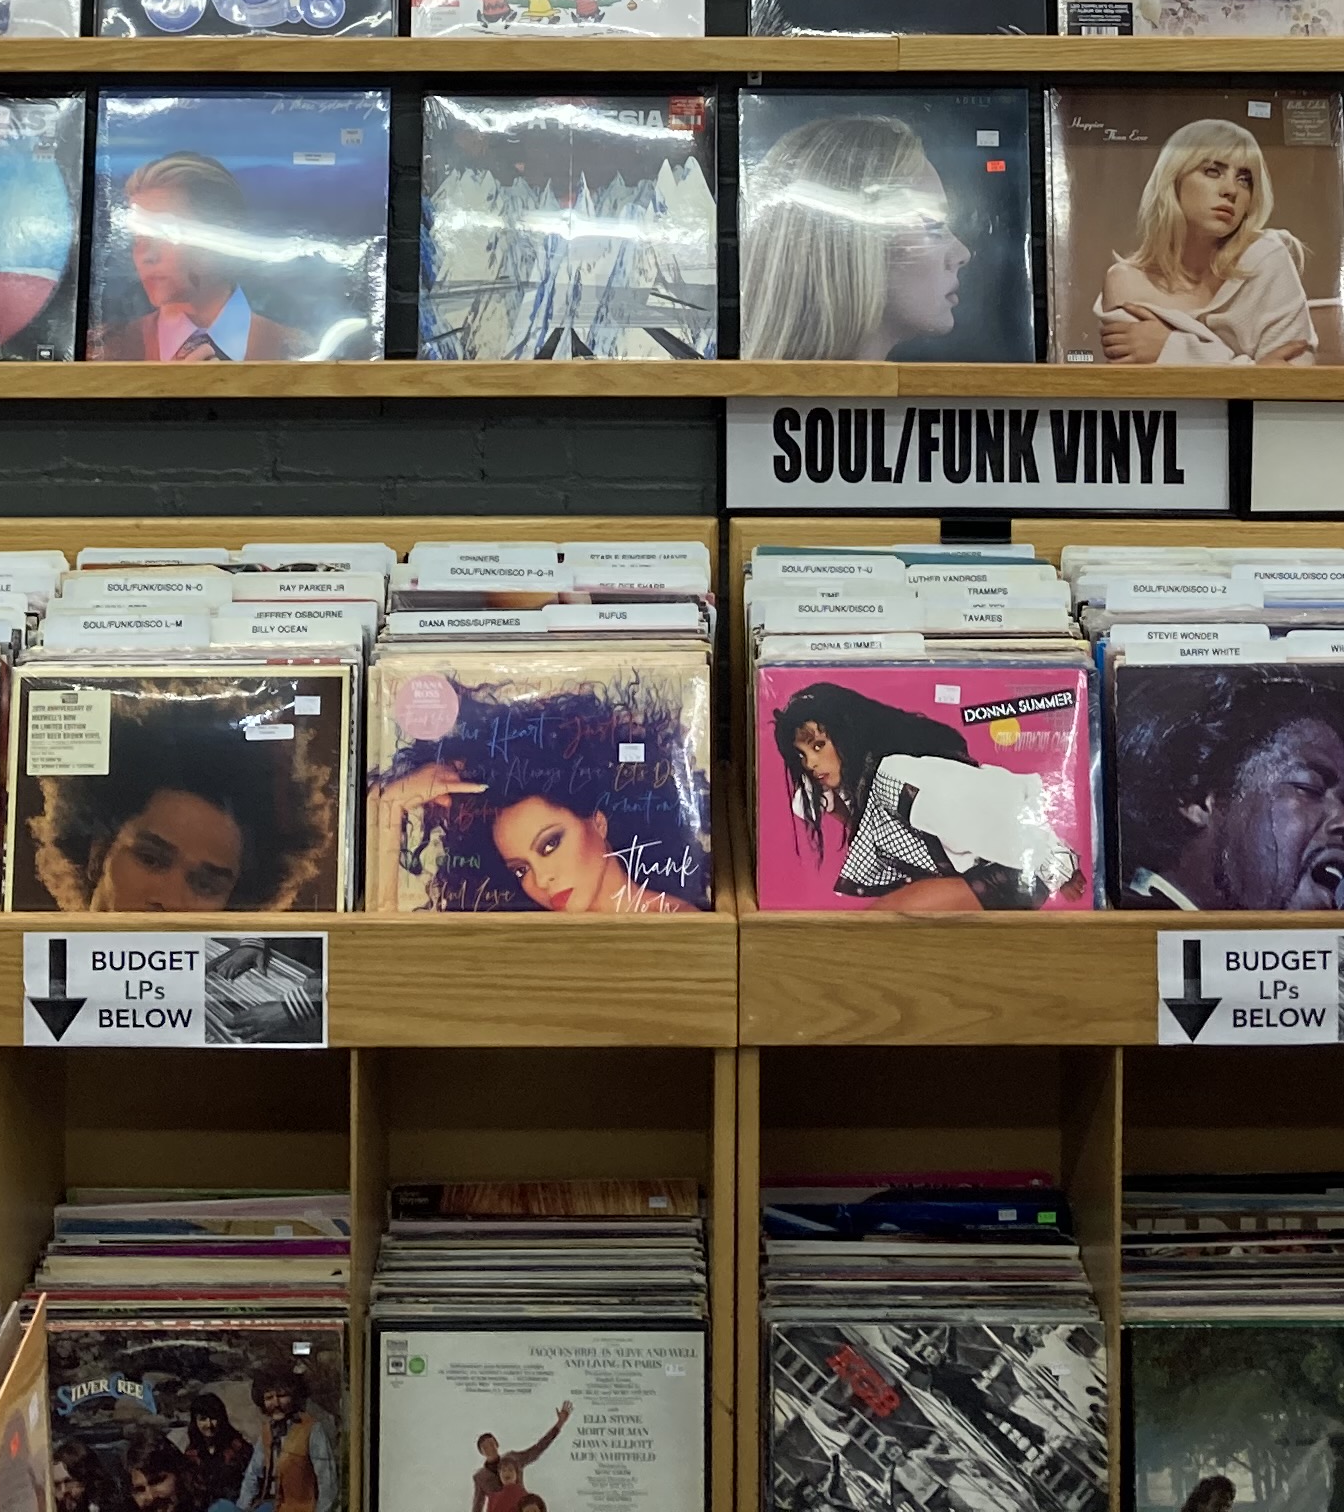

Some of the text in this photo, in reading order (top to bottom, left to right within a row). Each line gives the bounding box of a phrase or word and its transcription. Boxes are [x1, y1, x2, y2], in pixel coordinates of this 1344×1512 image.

[773, 407, 1184, 486] SOUL/FUNK VINYL
[279, 584, 345, 592] RAY PARKER JR
[599, 611, 627, 620] RUFUS
[277, 625, 308, 634] OCEAN
[1147, 632, 1218, 640] STEVIE WONDER
[1179, 648, 1240, 656] BARRY WHITE
[964, 691, 1073, 723] DONNA SUMMER
[603, 834, 699, 901] Thank
[91, 950, 199, 971] BUDGET
[1226, 950, 1332, 971] BUDGET
[124, 980, 166, 1001] LPs
[1259, 980, 1299, 1001] LPs
[98, 1008, 193, 1029] BELOW
[1233, 1007, 1326, 1029] BELOW
